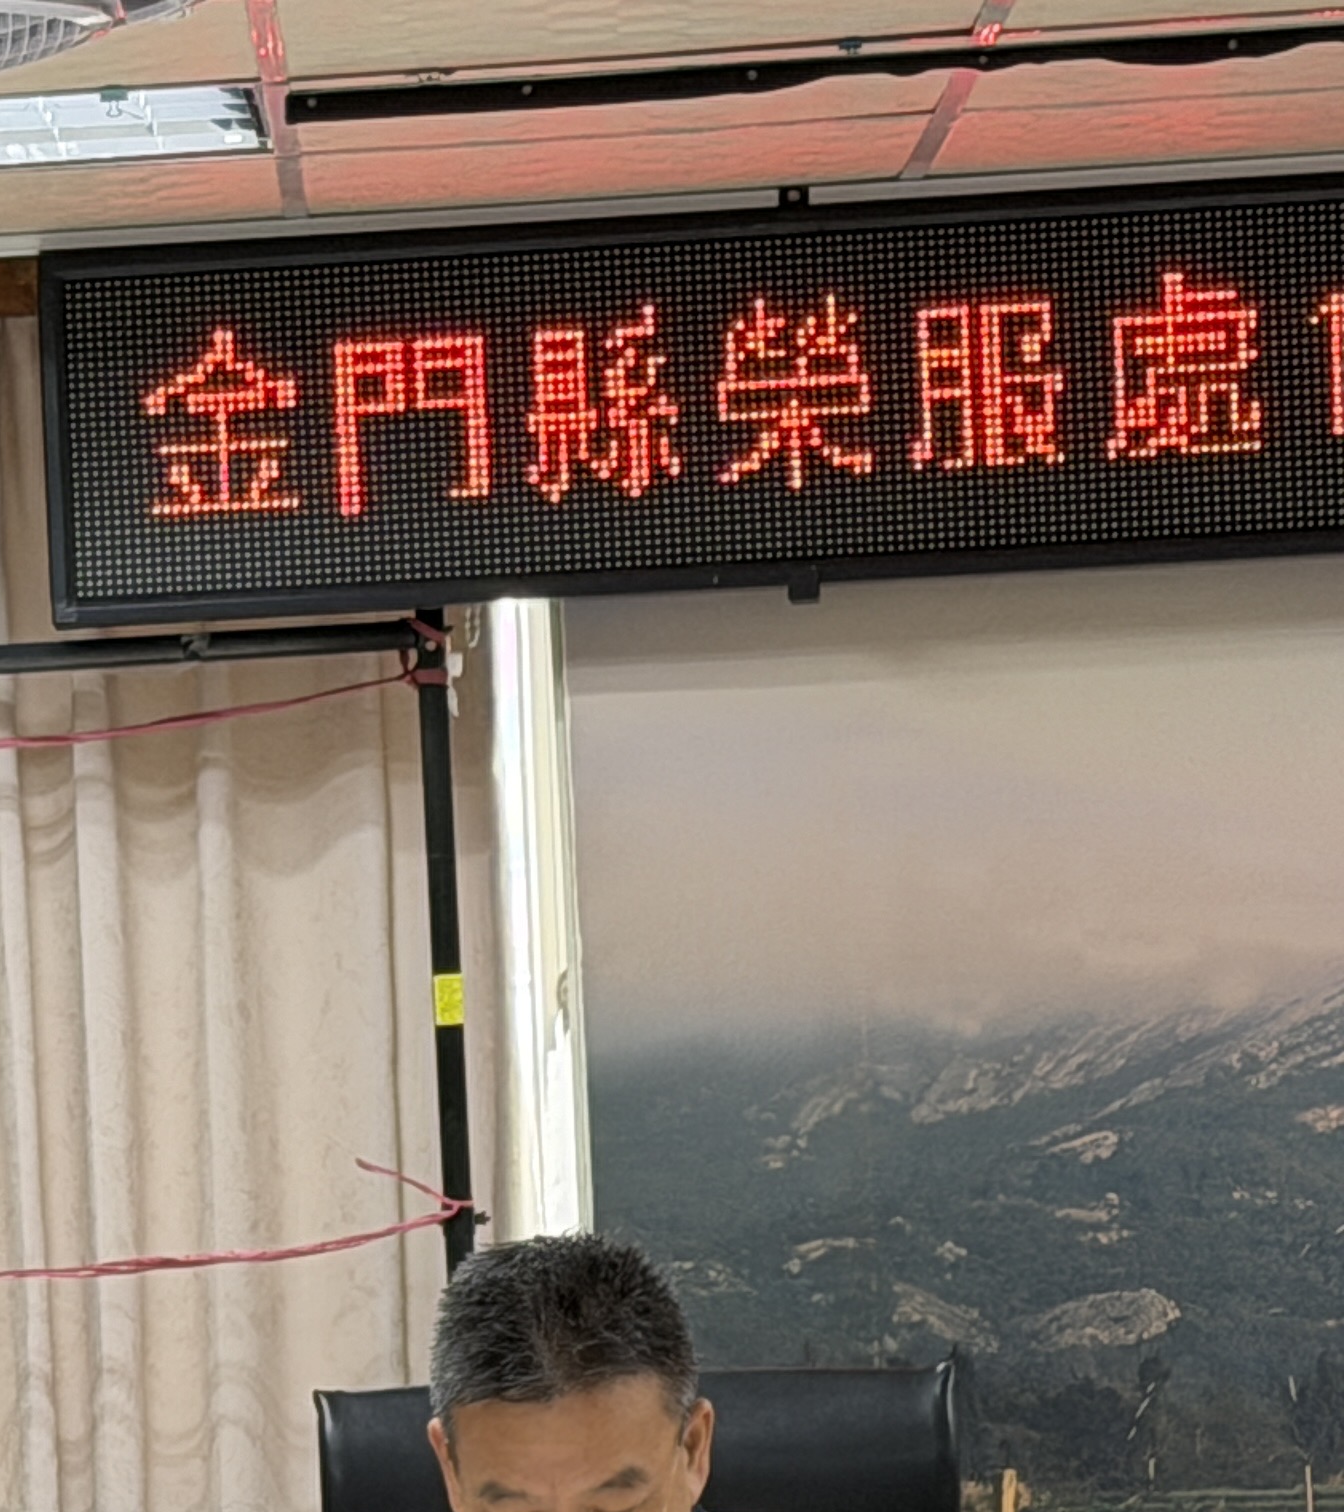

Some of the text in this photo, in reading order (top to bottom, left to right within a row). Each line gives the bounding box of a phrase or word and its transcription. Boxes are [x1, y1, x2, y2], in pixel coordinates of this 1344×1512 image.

[142, 270, 1343, 516] 金門縣榮服處
